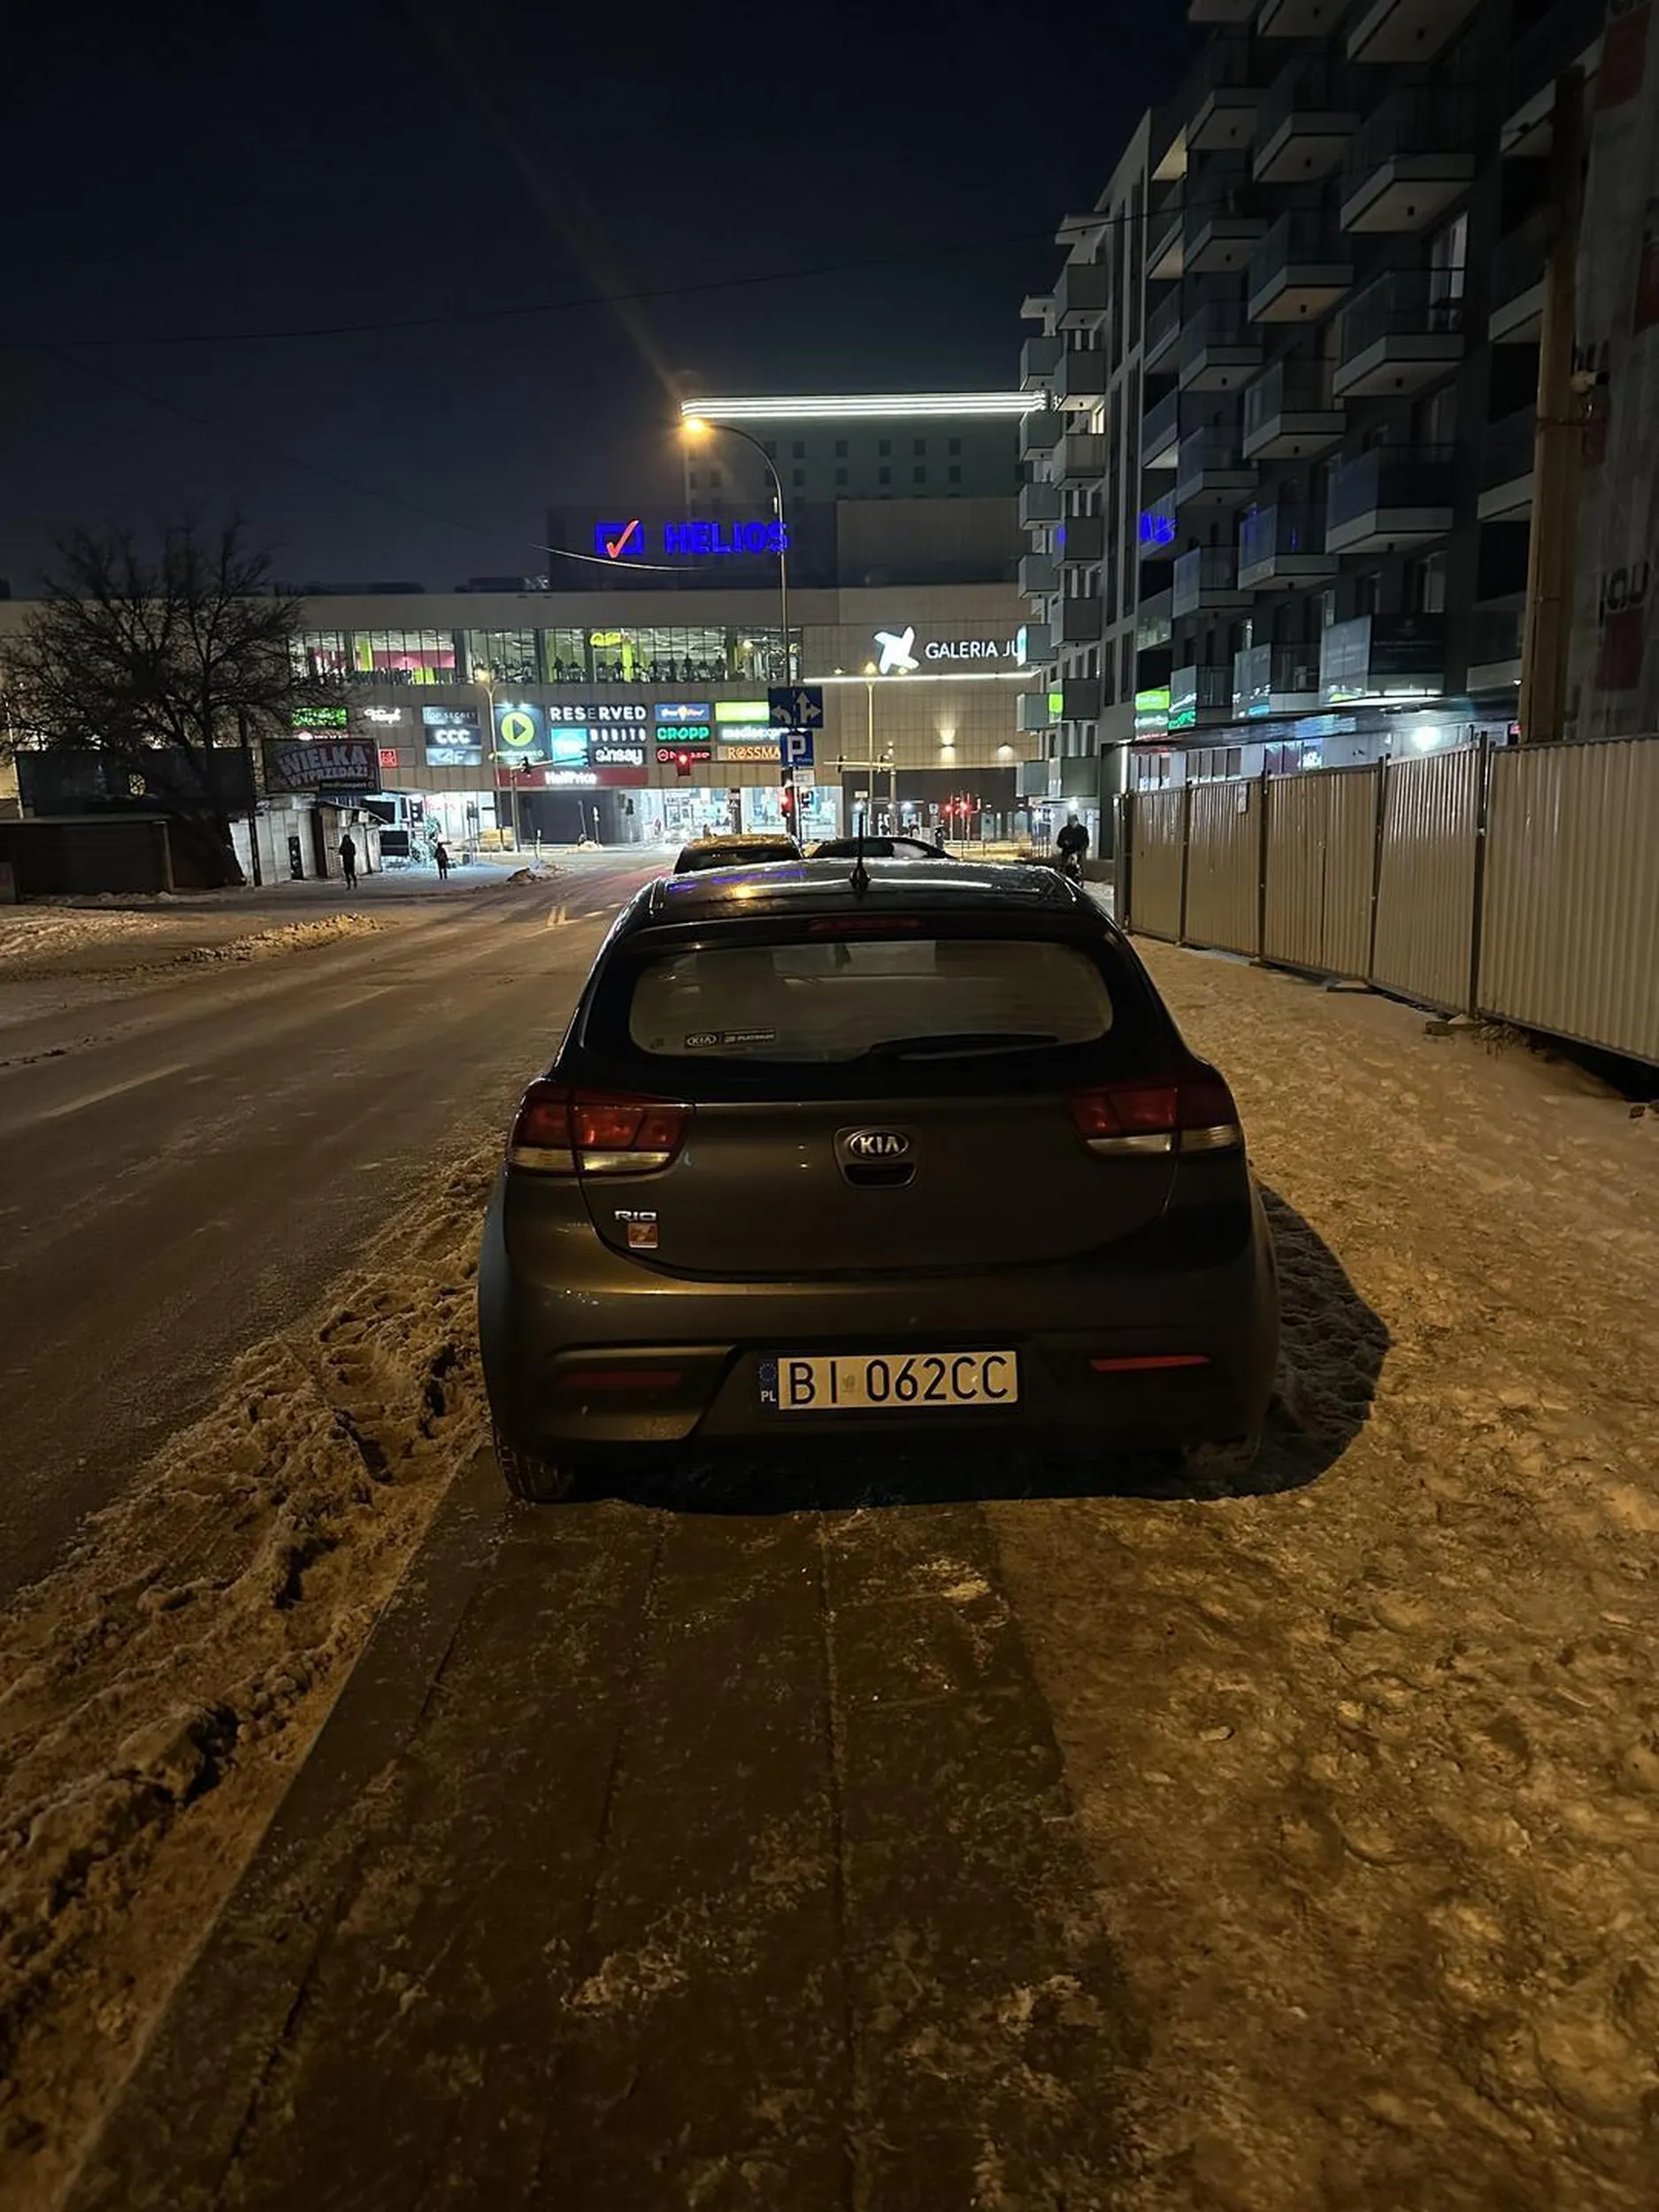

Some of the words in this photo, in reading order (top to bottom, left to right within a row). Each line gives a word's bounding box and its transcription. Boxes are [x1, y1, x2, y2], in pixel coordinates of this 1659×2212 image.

[665, 522, 789, 555] HELIOS
[925, 641, 998, 659] GALERIA
[549, 706, 647, 721] RESERVED
[434, 729, 472, 745] CCC
[657, 726, 710, 741] CROPP
[595, 746, 643, 765] sinsay
[787, 735, 806, 764] P
[280, 745, 368, 778] WIELKA
[545, 771, 597, 785] HalfPrice
[859, 1135, 901, 1154] KIA
[614, 1209, 657, 1222] RIO
[761, 1388, 777, 1402] PL
[790, 1362, 837, 1404] BI
[866, 1356, 1007, 1402] 062CC
